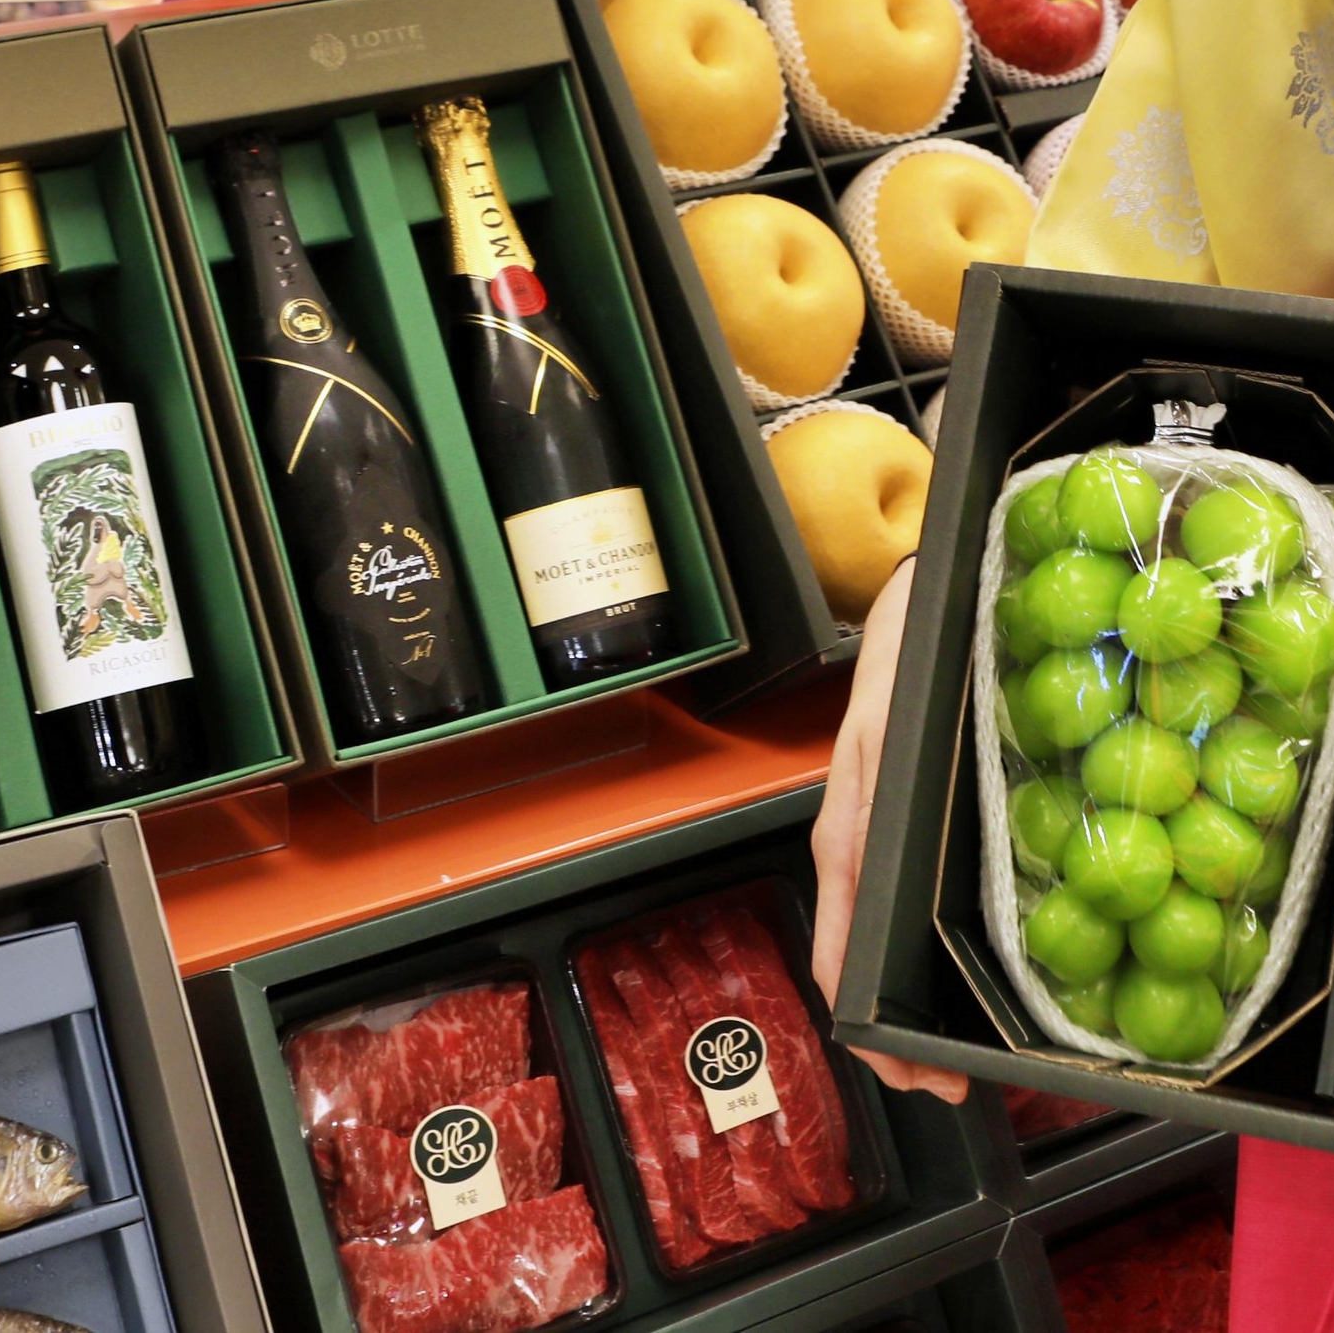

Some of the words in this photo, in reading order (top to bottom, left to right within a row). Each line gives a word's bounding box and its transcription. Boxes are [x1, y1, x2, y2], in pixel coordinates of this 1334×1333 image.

[350, 24, 423, 48] LOTTE
[464, 156, 517, 259] MOËT
[402, 526, 442, 580] CHANDON
[533, 558, 583, 585] MOËT
[585, 559, 597, 571] &
[605, 602, 637, 617] BRUT
[88, 646, 167, 676] RICASOLI
